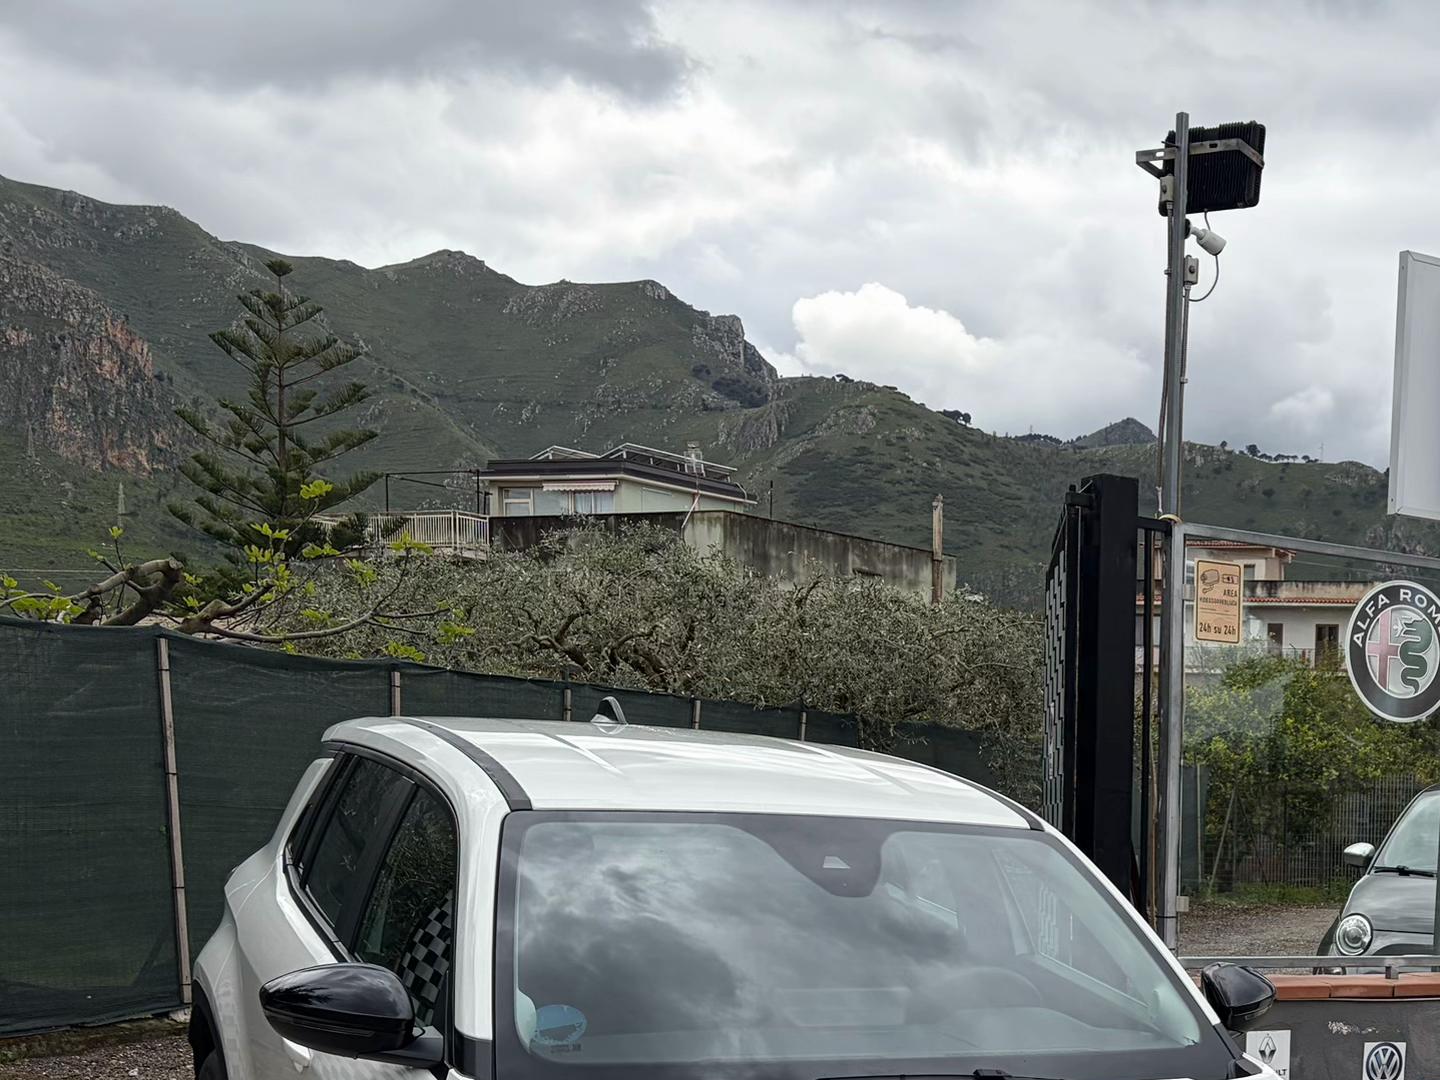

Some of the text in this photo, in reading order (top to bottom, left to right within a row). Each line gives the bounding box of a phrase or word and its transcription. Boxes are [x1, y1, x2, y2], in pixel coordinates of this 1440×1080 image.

[1199, 622, 1236, 635] 24h su 24h
[1352, 593, 1391, 648] ALFA
